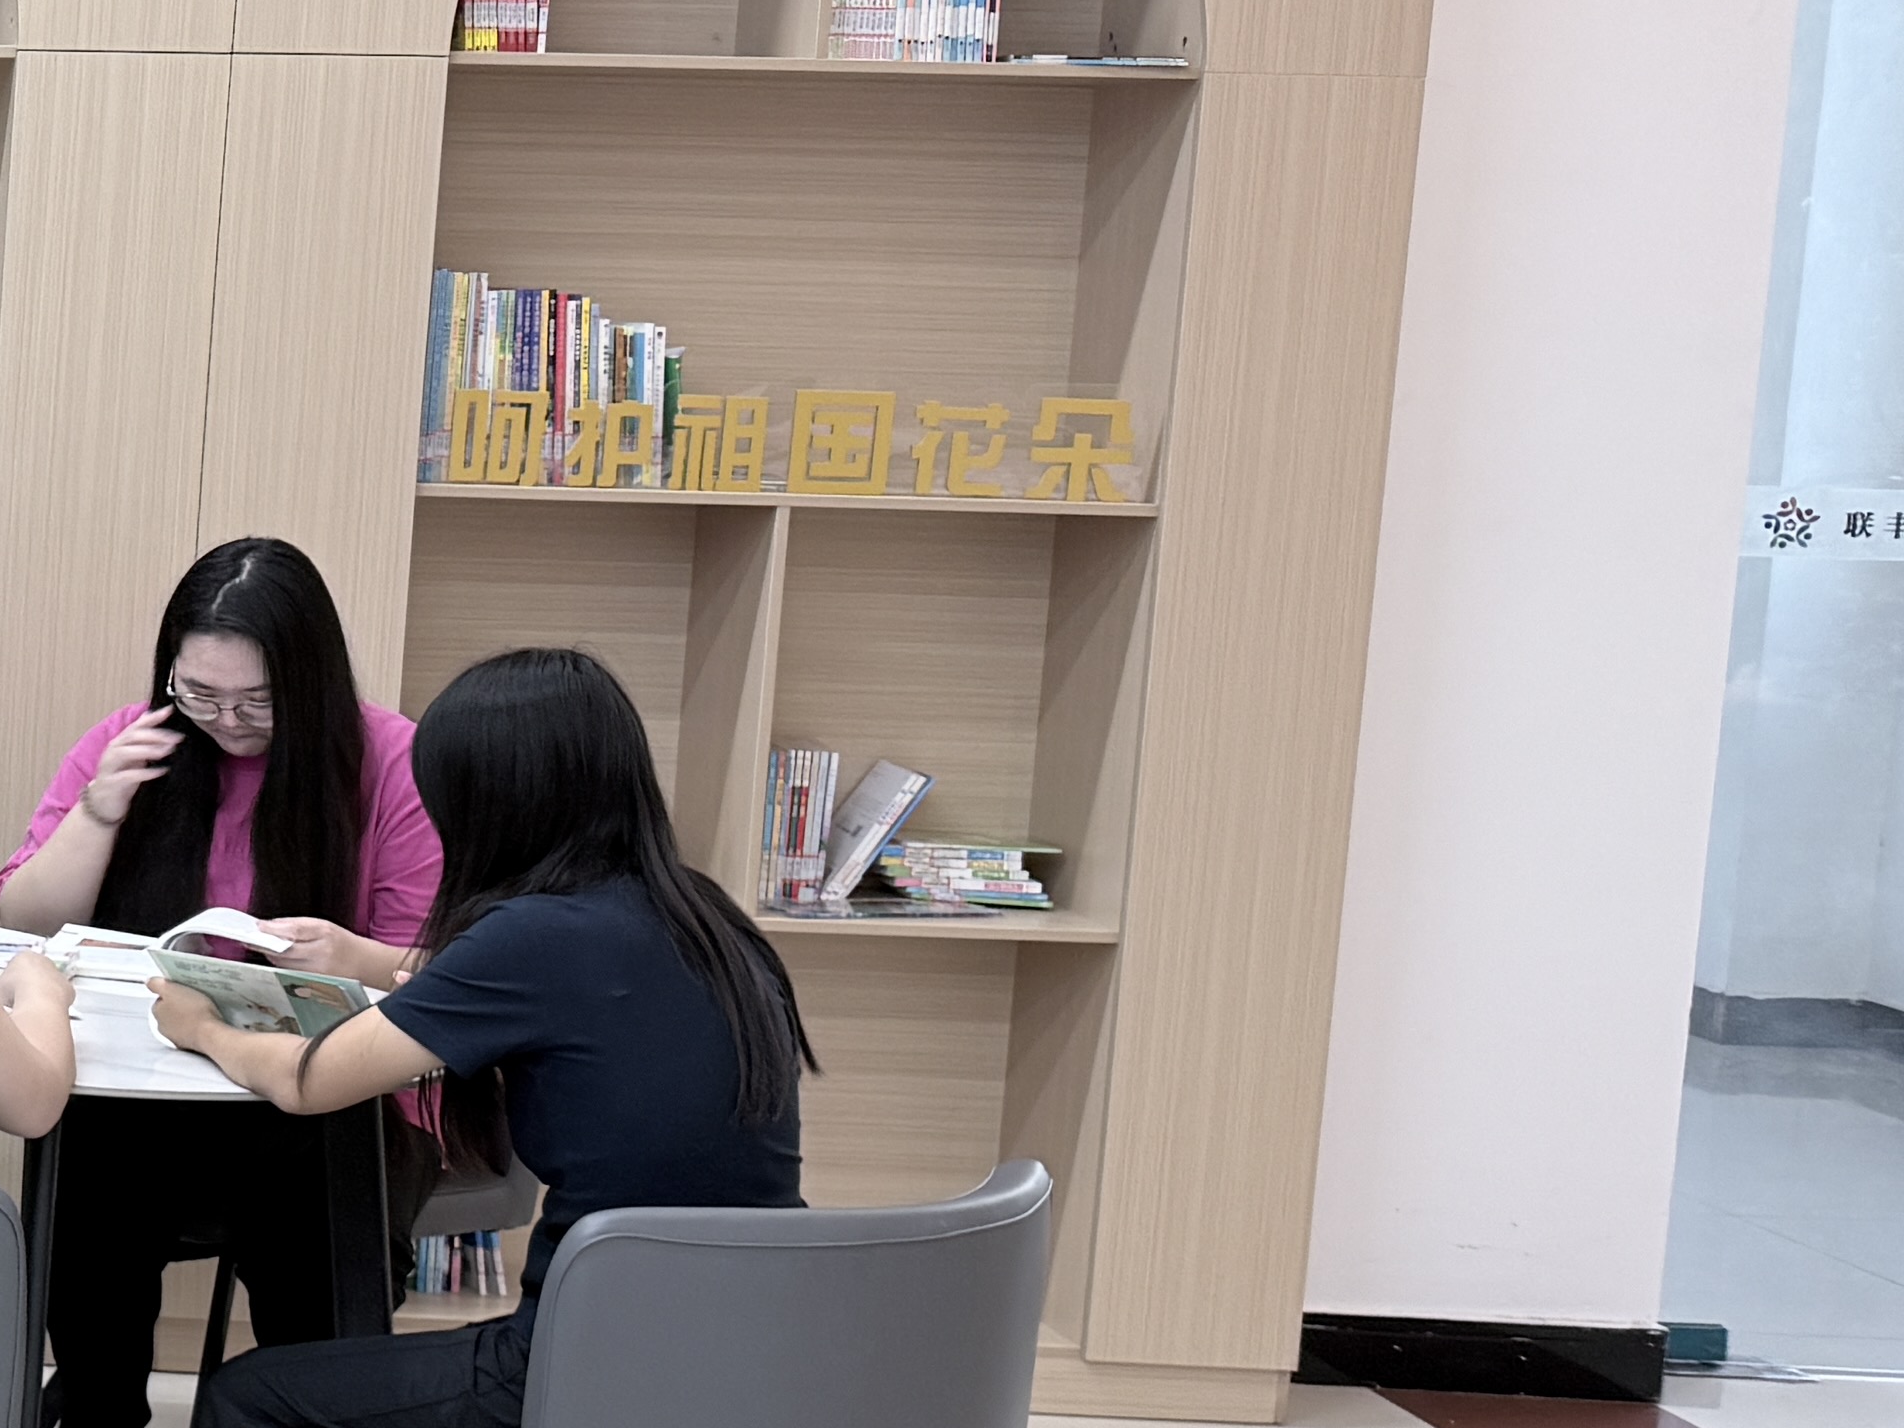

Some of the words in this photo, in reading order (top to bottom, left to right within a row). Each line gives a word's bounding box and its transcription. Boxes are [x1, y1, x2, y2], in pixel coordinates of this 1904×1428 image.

[448, 388, 1133, 502] 呵护祖国花朵
